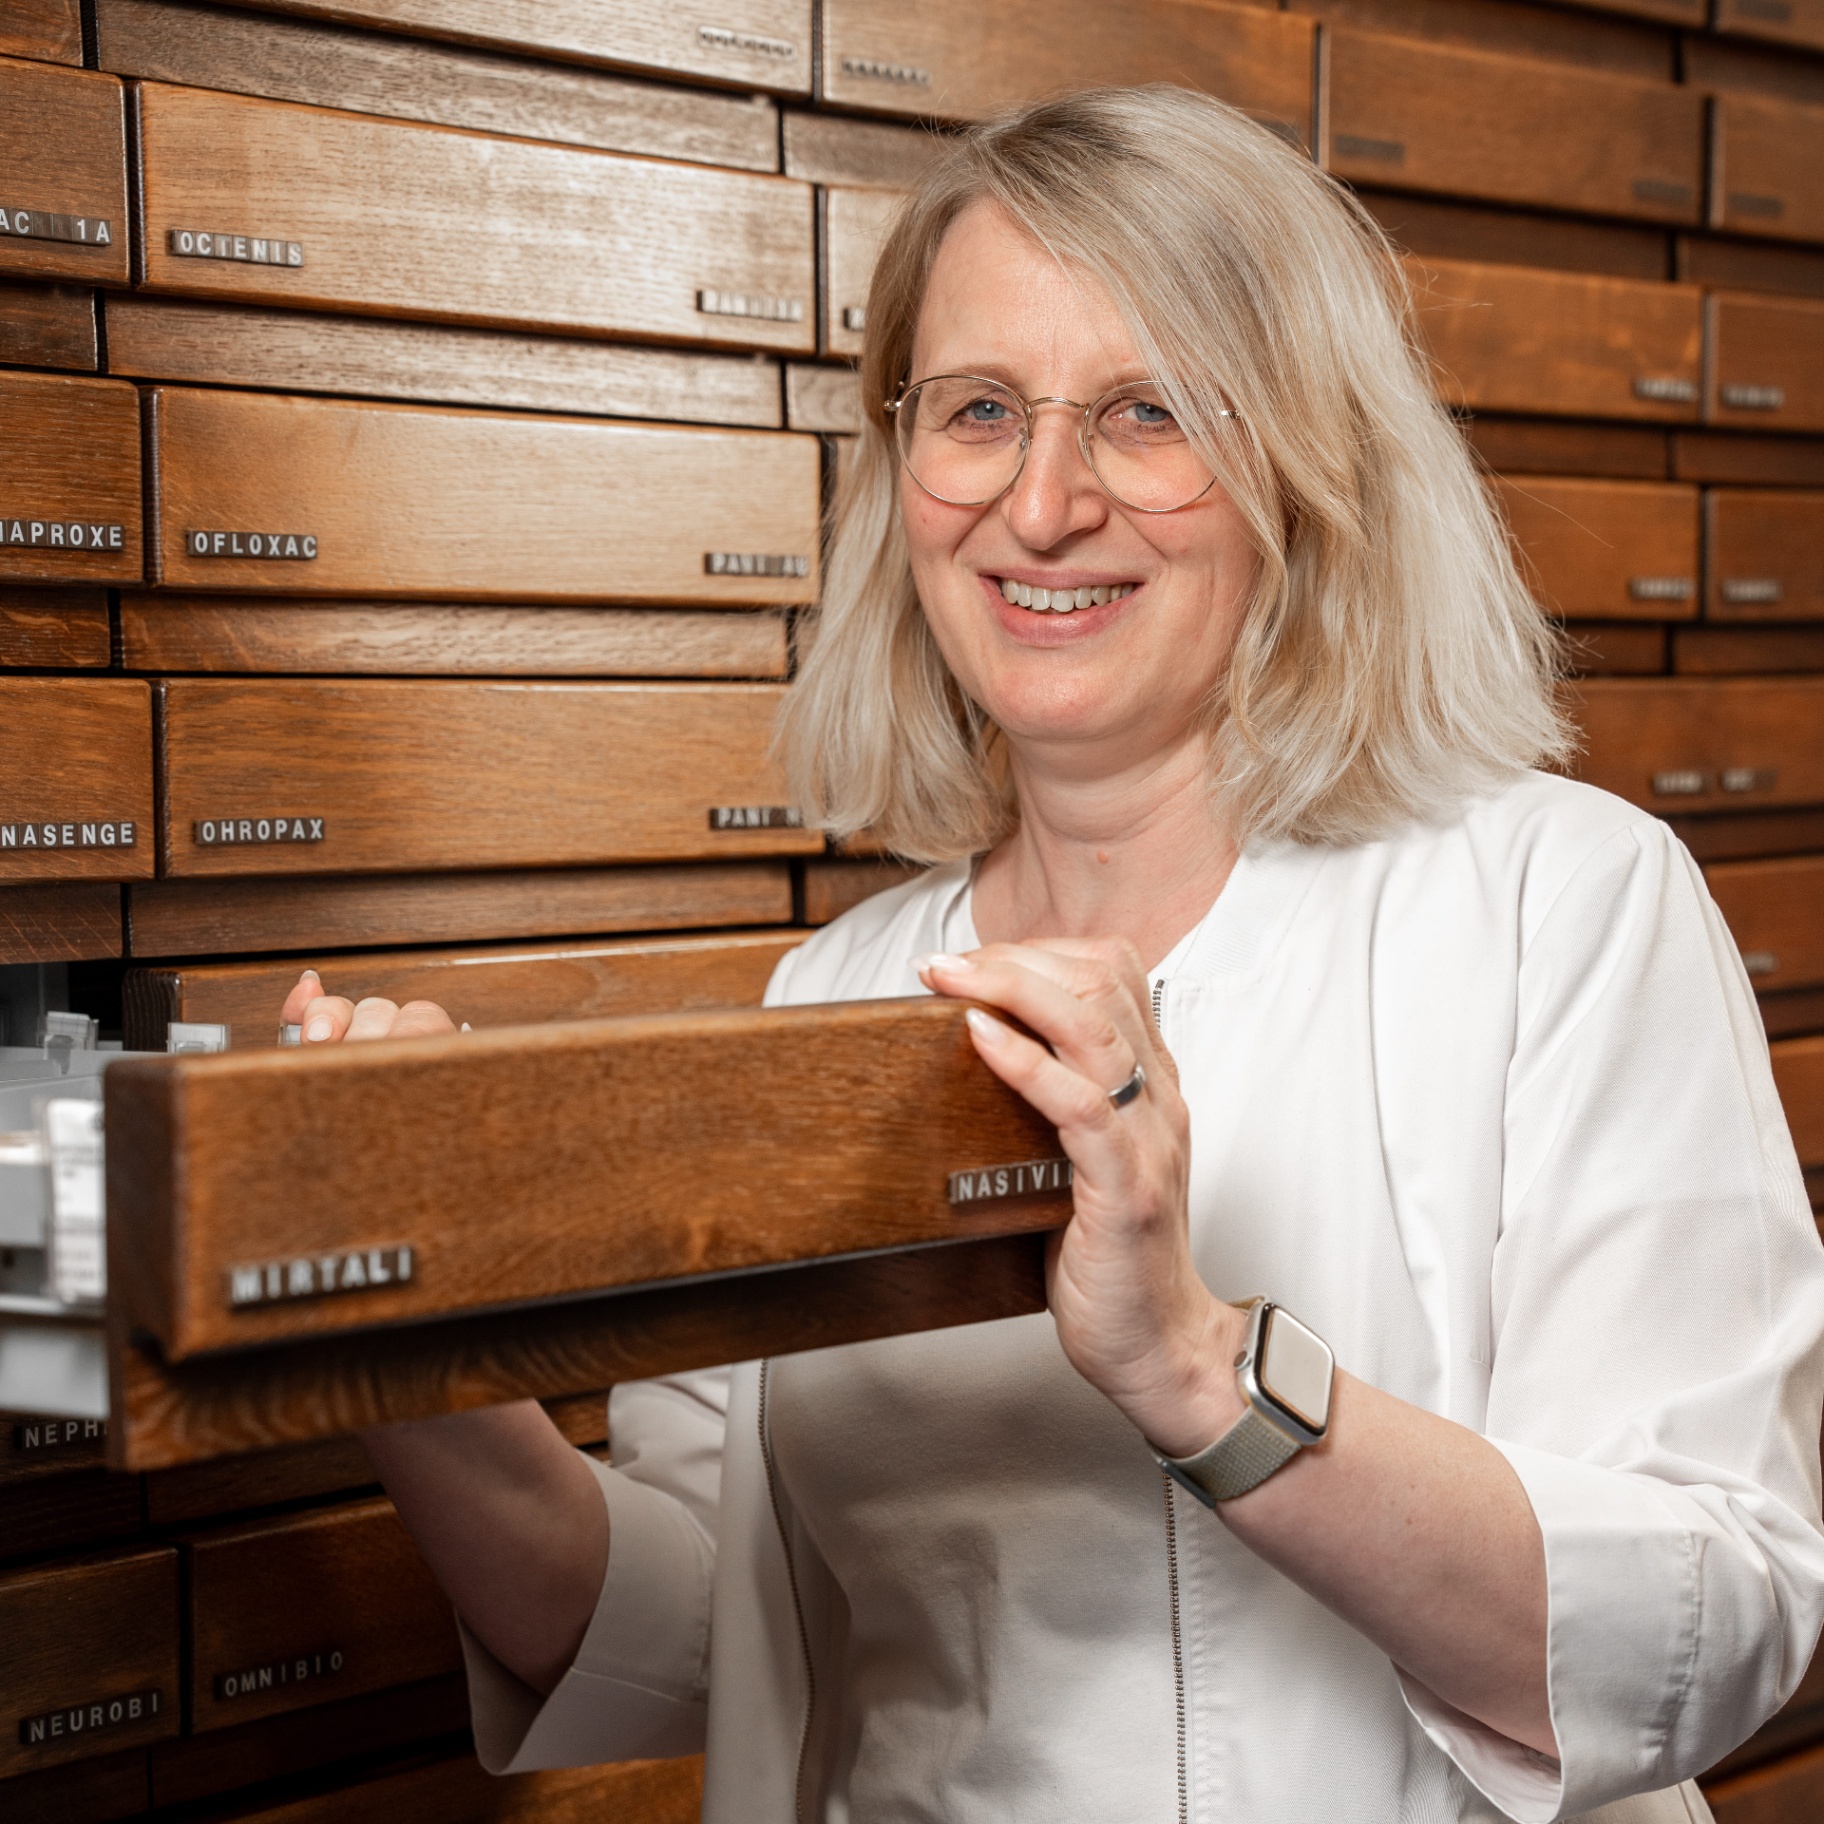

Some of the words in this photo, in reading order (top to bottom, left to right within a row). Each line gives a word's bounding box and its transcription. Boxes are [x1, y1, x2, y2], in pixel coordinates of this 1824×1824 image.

[0, 208, 30, 234] AC
[77, 219, 110, 243] 1A
[0, 521, 123, 547] APROXE
[194, 532, 317, 557] OFLOXAC
[1, 823, 134, 846] NASENGE
[202, 818, 324, 842] OHROPAX
[224, 1651, 344, 1697] OMNIBIO
[29, 1693, 158, 1743] NEUROBI
